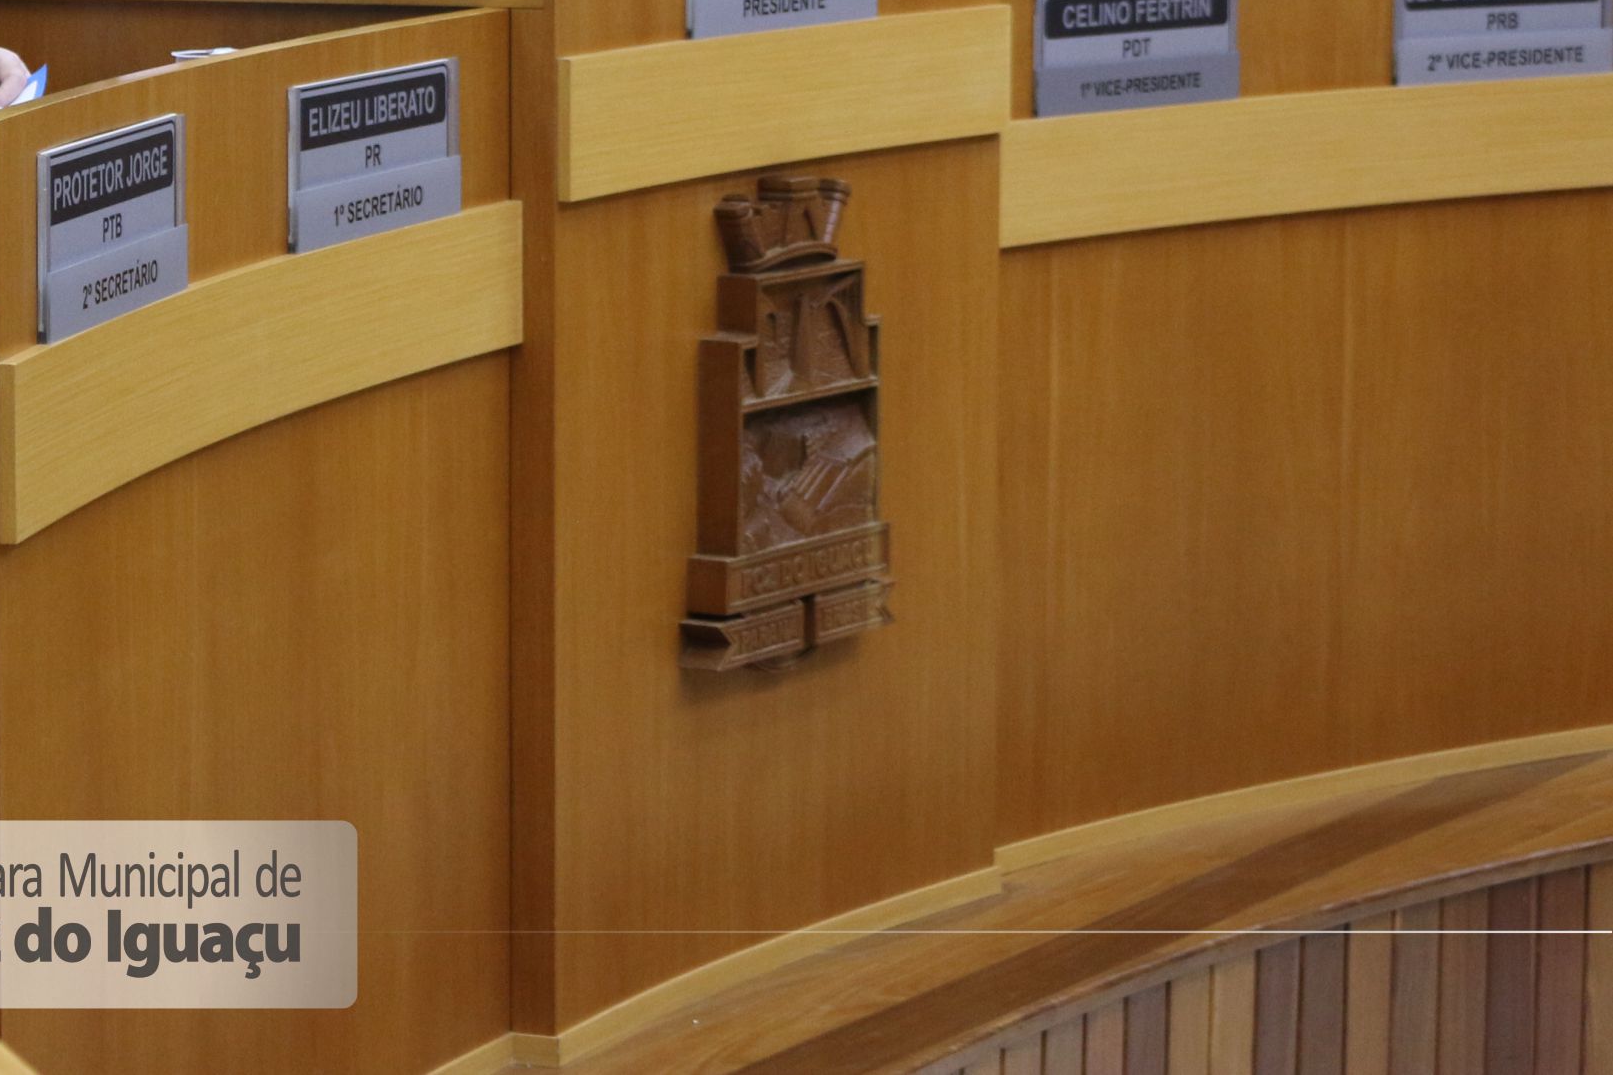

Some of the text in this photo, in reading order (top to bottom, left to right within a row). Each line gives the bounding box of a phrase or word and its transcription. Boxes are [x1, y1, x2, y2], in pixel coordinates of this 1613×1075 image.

[1062, 2, 1132, 29] CELINO
[1486, 12, 1519, 30] PRB
[1122, 38, 1151, 58] PDT
[1445, 46, 1584, 70] VICE-PRESIDENTE
[1094, 72, 1202, 97] VICE-PRESIDENTE
[308, 85, 436, 138] ELIZEU LIBERATO
[365, 144, 382, 168] PR
[53, 144, 168, 211] PROTETOR JORGE
[347, 184, 423, 224] SECRETÁRIO
[102, 213, 122, 243] PTB
[94, 259, 158, 305] SECRETÁRIO
